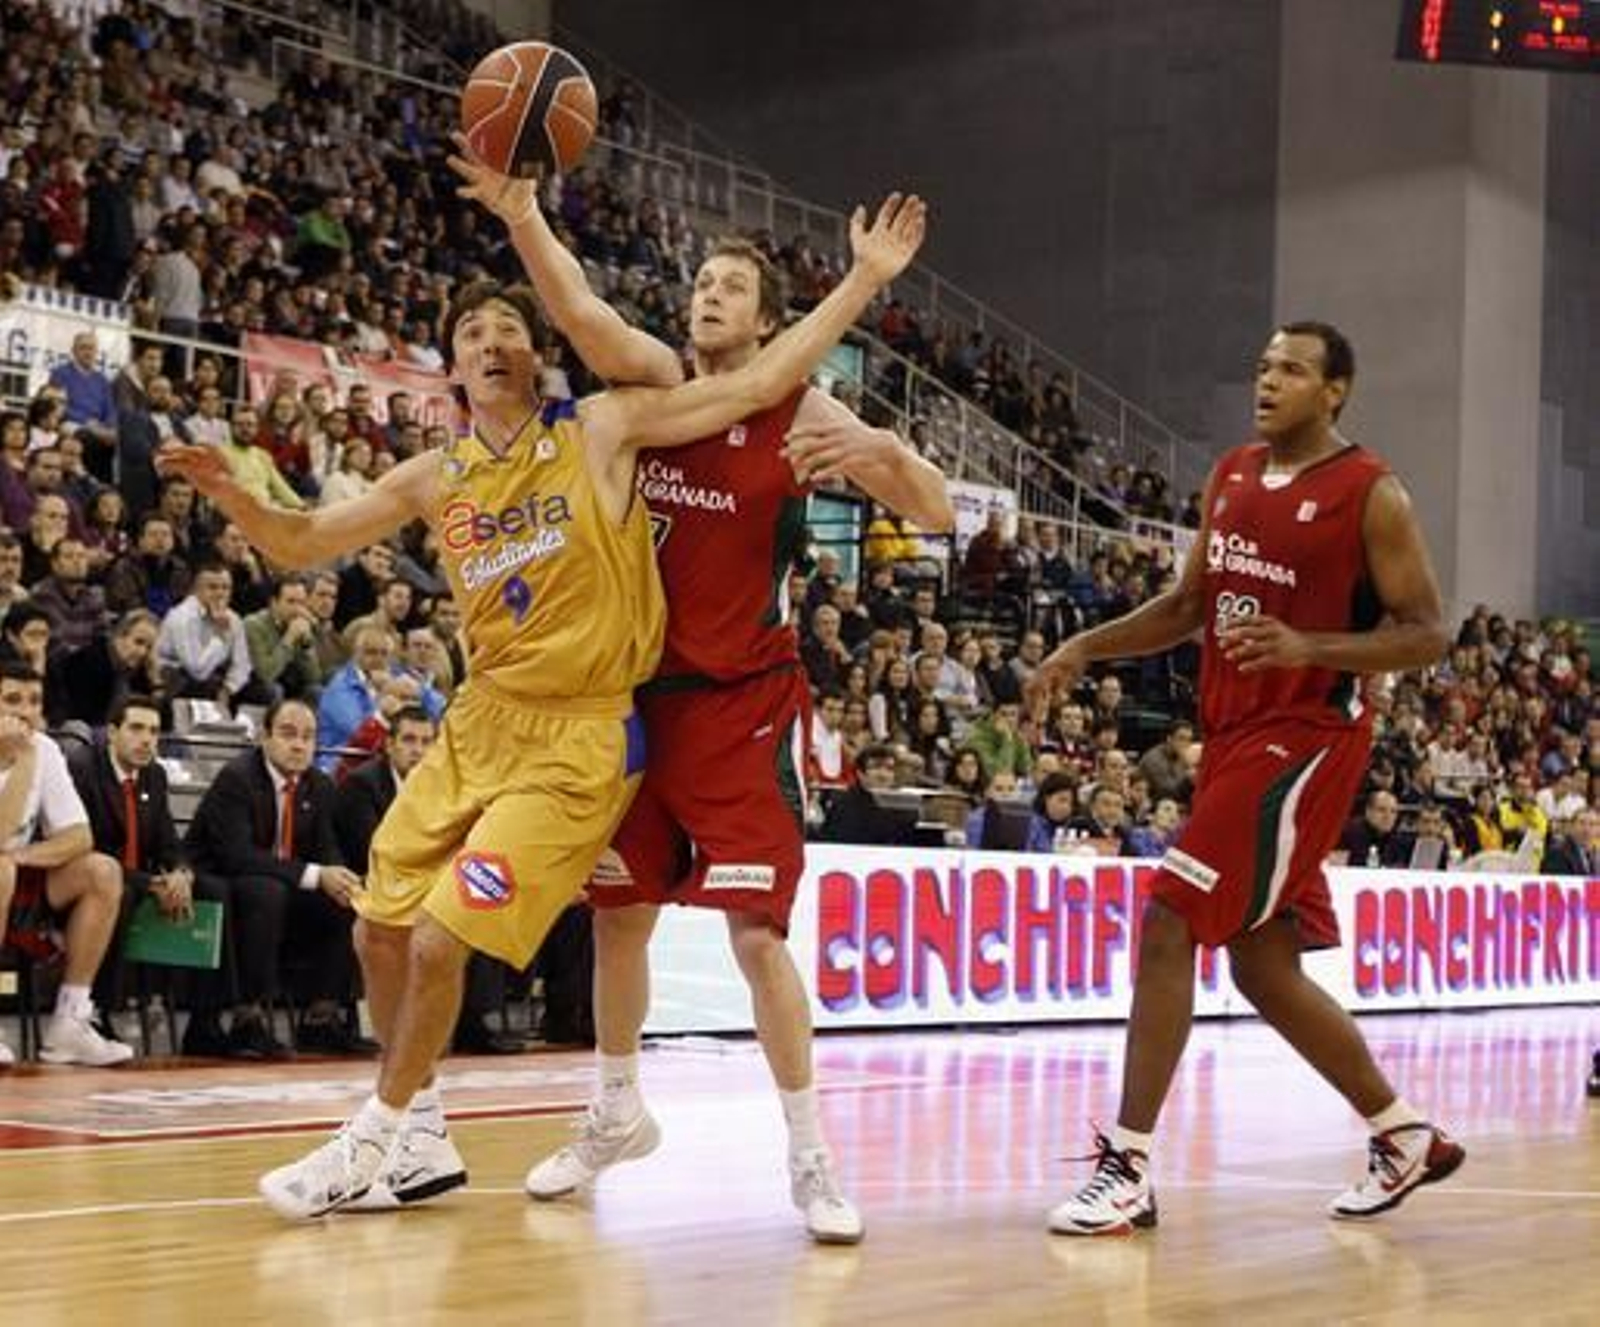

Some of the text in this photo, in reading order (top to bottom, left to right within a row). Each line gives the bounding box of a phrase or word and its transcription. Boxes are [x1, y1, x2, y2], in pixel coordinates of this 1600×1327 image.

[442, 491, 572, 551] asefa
[643, 480, 737, 514] GRANADA
[502, 573, 533, 626] 9
